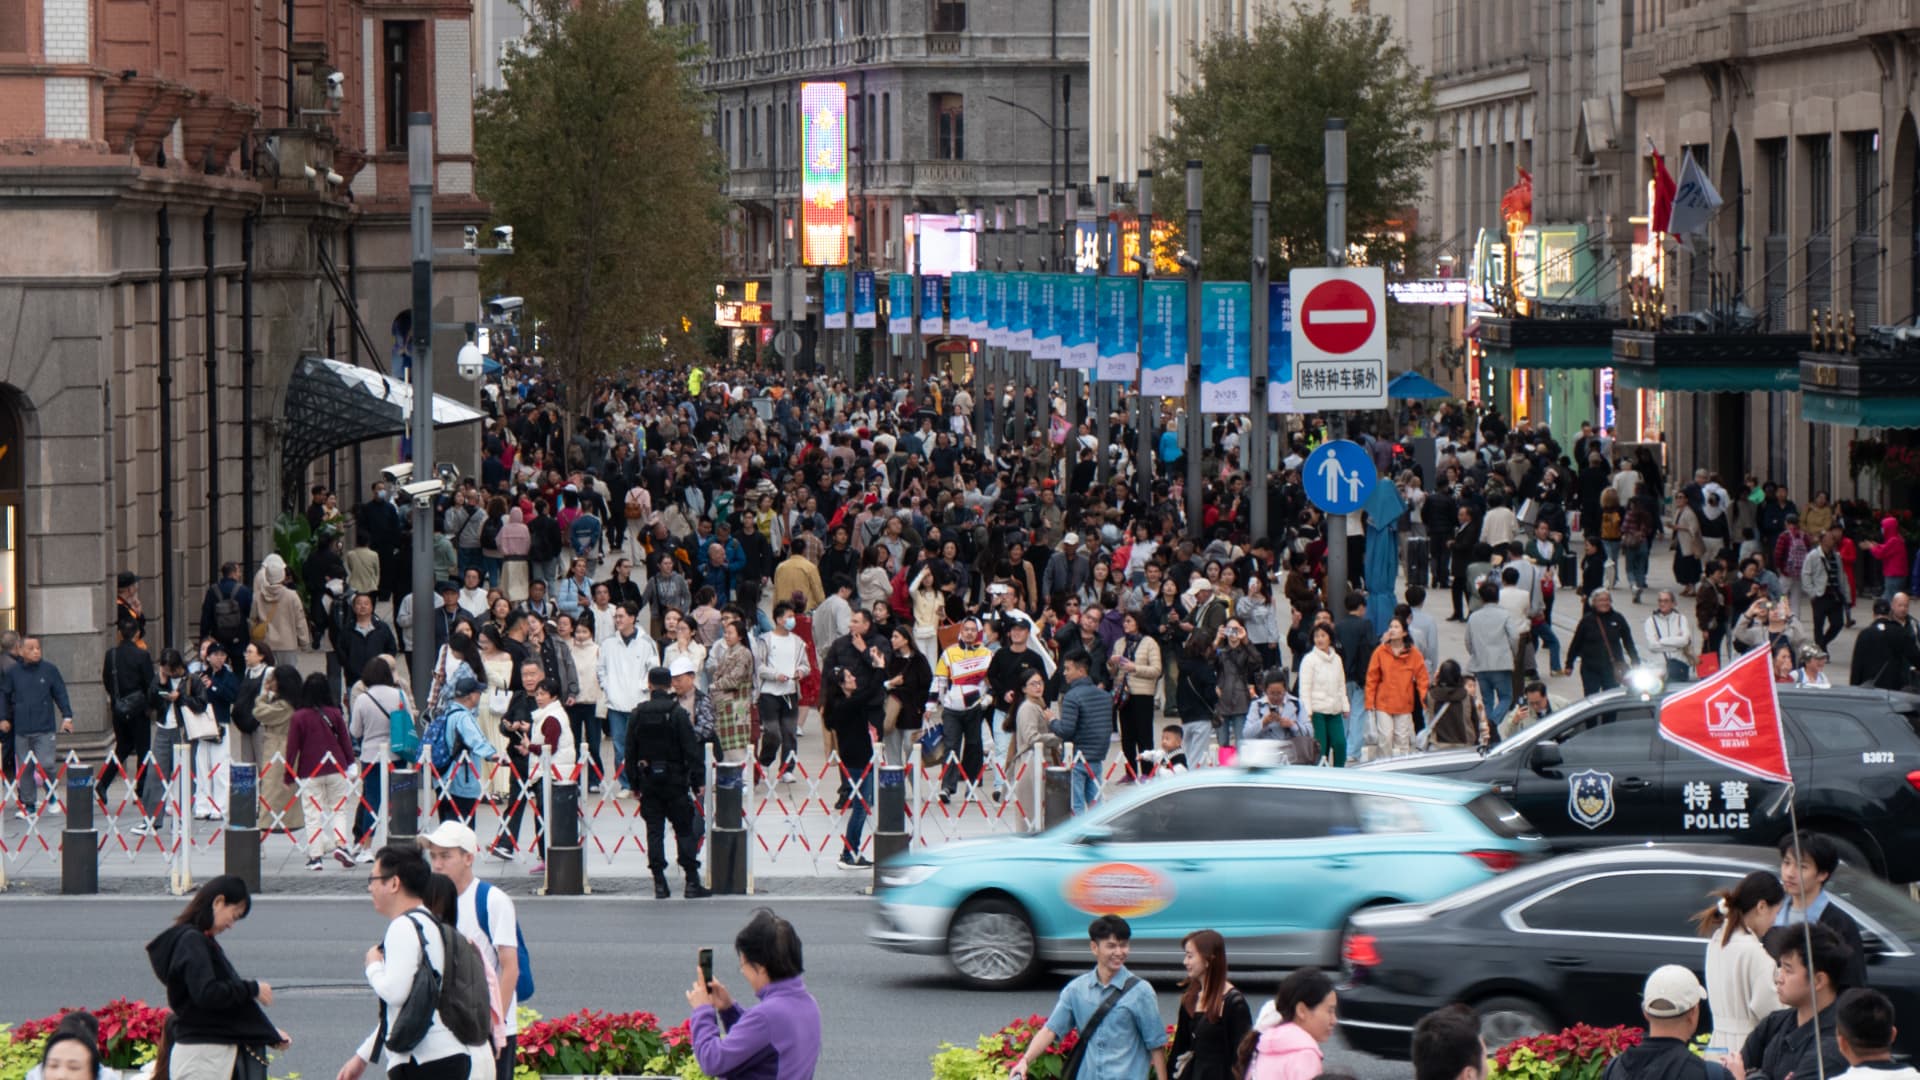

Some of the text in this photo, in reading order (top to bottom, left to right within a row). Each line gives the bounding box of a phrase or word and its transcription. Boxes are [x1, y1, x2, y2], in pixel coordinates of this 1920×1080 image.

[1301, 367, 1378, 391] 除特种车辆外
[1683, 780, 1749, 811] 特警
[1683, 813, 1750, 830] POLICE
